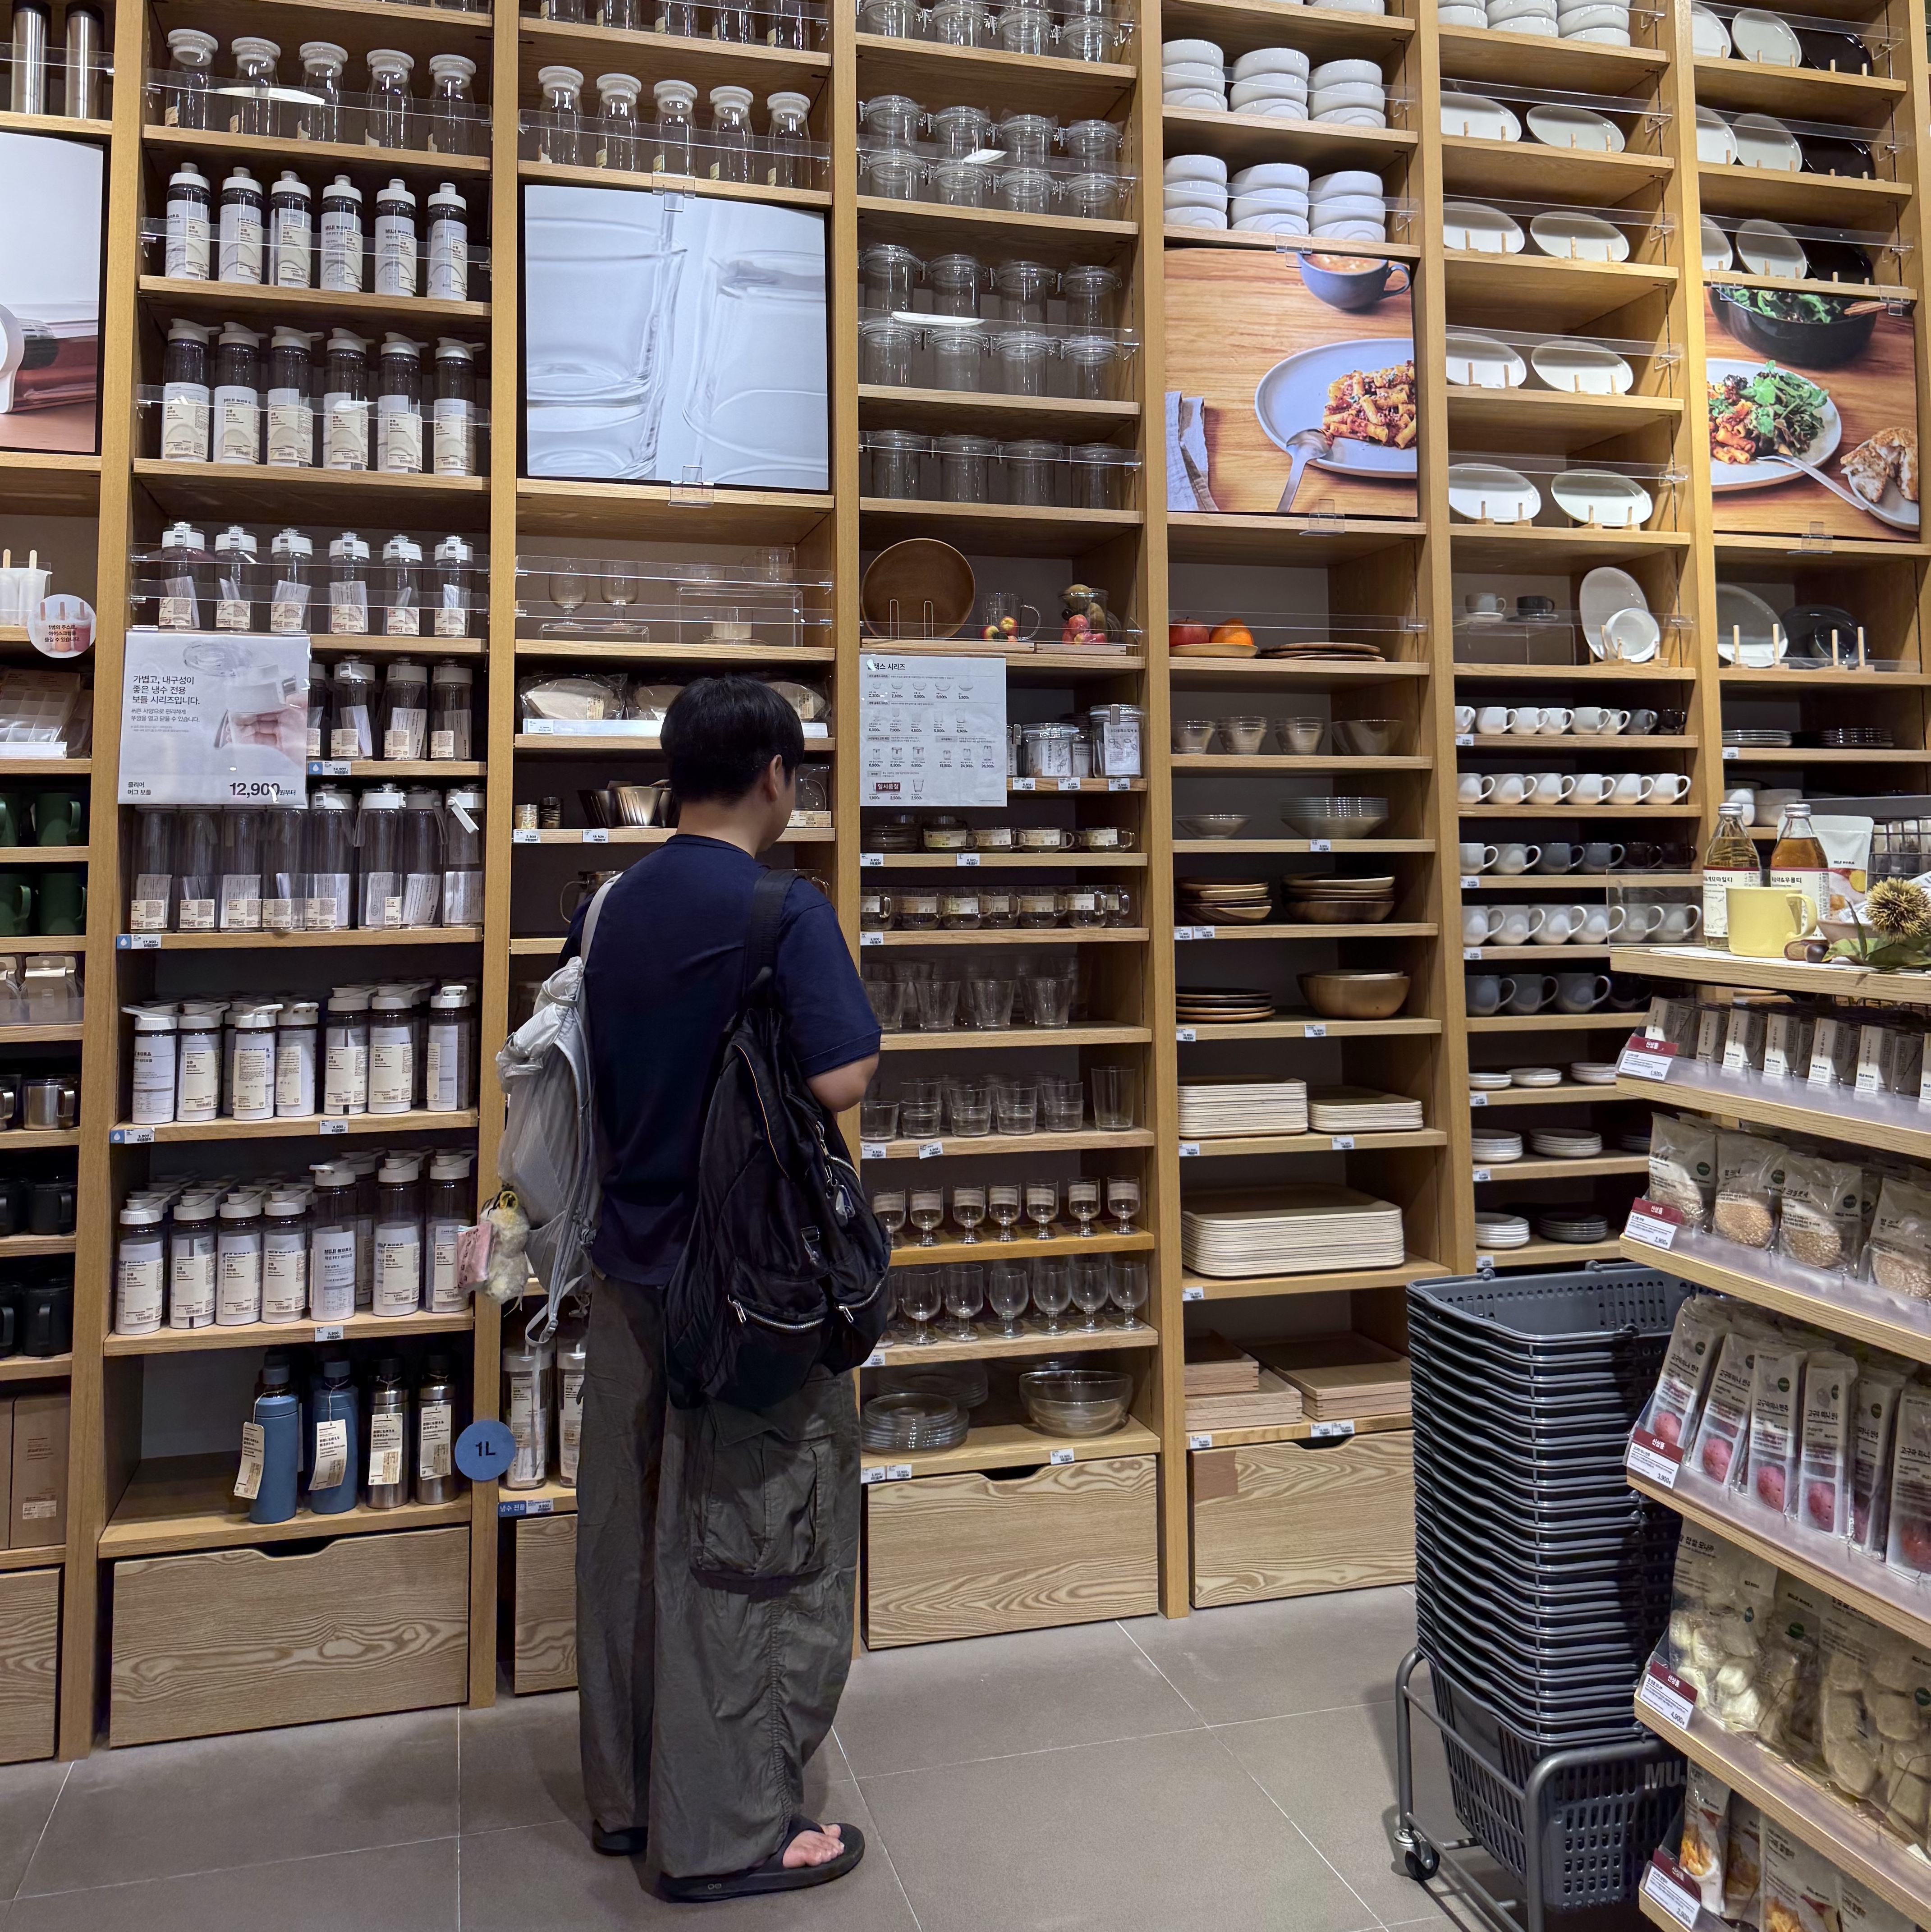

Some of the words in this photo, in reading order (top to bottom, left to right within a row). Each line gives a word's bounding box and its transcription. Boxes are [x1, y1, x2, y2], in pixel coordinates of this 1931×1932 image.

[133, 675, 160, 684] 가볍고,
[162, 676, 194, 685] 내구성이
[133, 685, 149, 693] 좋은
[151, 685, 168, 694] 냉수
[170, 686, 186, 694] 전용
[132, 695, 148, 704] 보틀
[150, 696, 200, 705] 시리즈입니다.
[1720, 1369, 1732, 1380] 고구마
[1757, 1399, 1771, 1408] 고구마
[1779, 1403, 1789, 1413] 만주
[475, 1441, 496, 1457] 1L
[1652, 1439, 1665, 1450] 신상품
[1900, 1446, 1917, 1456] 고구마
[1698, 1541, 1715, 1552] 모나카
[1668, 1675, 1680, 1688] 신상품
